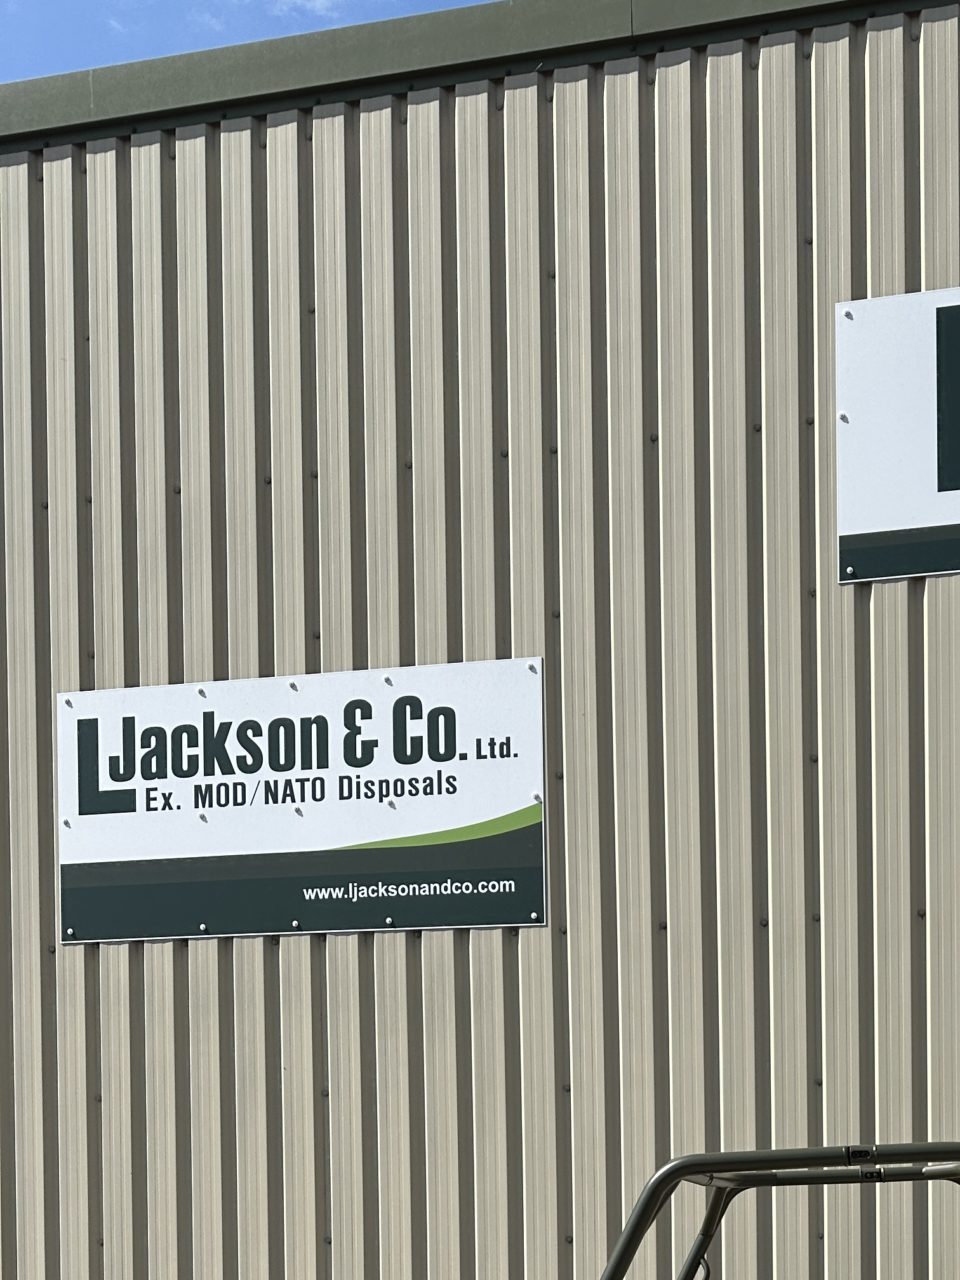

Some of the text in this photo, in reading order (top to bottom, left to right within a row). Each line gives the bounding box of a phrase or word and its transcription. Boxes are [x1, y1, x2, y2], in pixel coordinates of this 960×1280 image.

[343, 698, 379, 769] &
[392, 695, 468, 765] Co.
[475, 737, 519, 760] Ltd.
[145, 769, 458, 811] Ex. MOD/NATO Disposals
[302, 878, 516, 903] www.ljacksonandco.com
